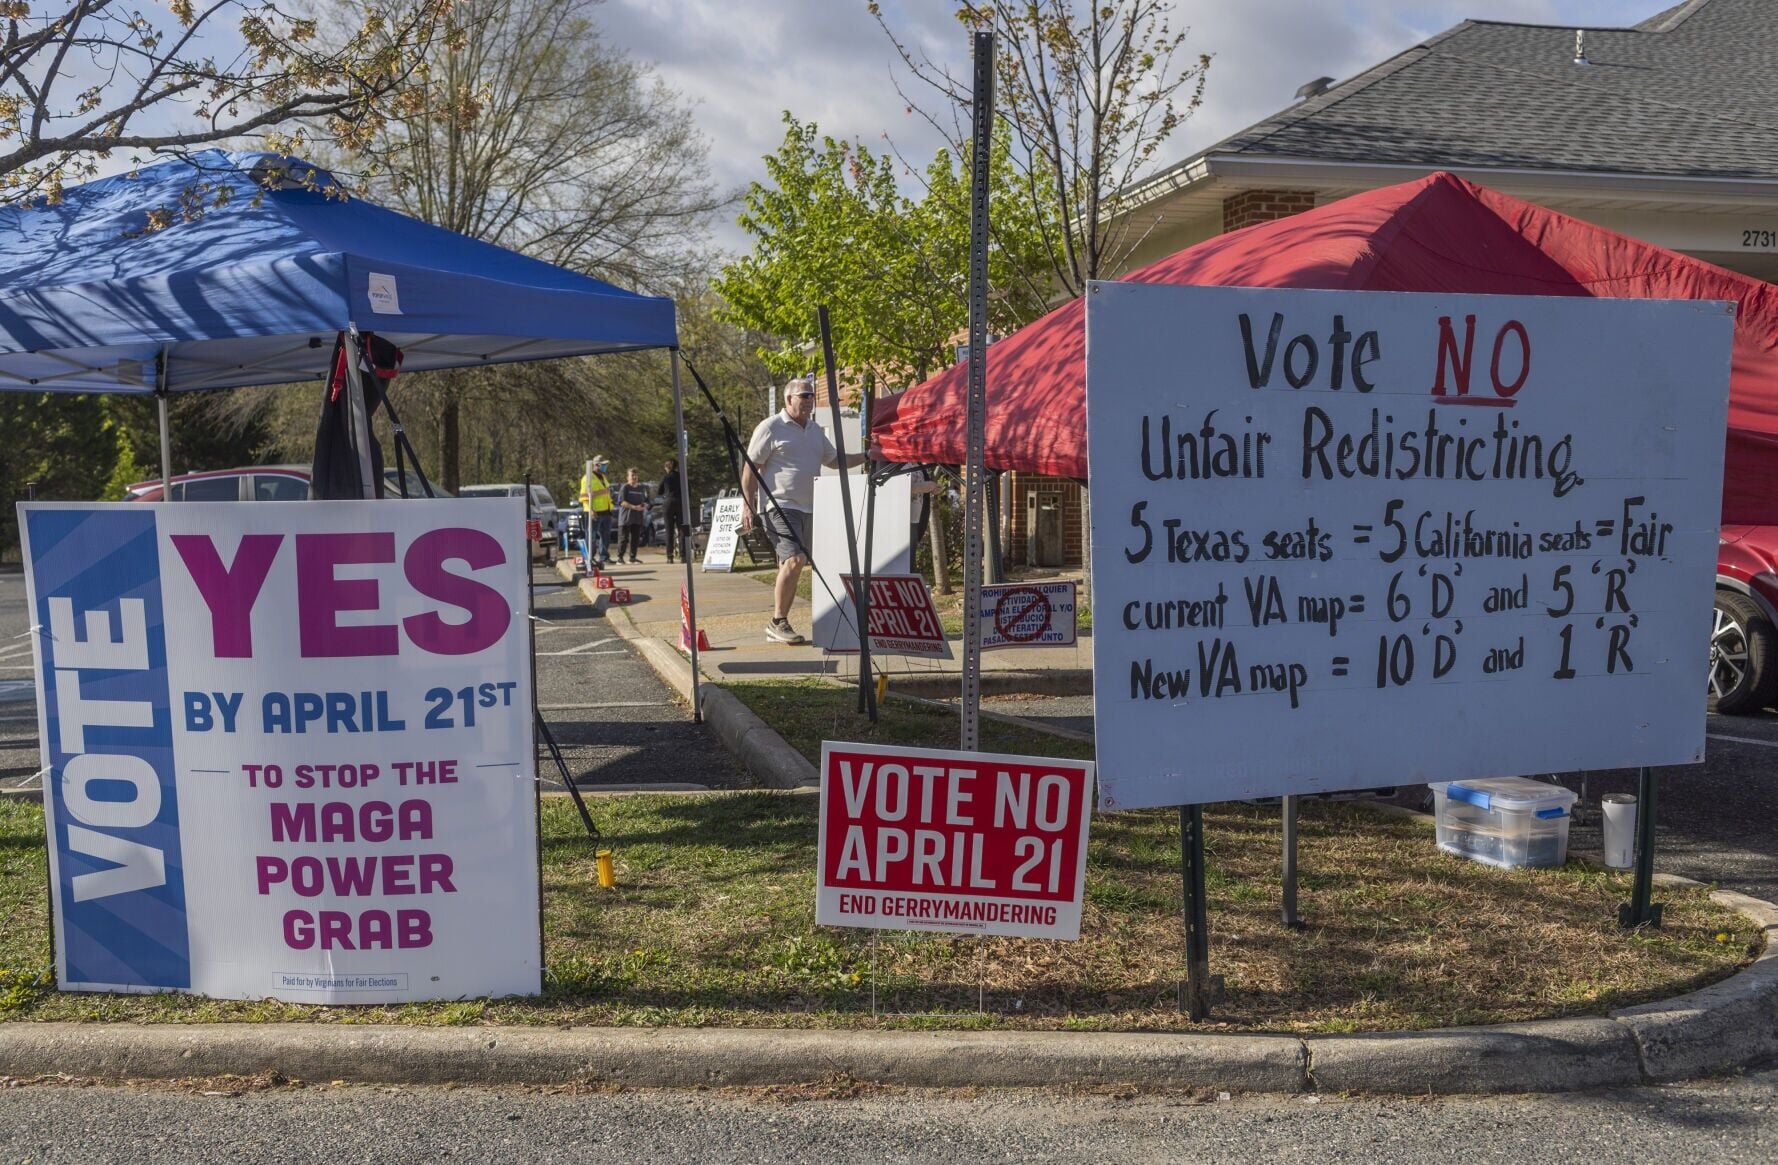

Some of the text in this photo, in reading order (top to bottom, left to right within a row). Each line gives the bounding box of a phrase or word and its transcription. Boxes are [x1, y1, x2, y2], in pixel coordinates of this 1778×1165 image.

[1742, 230, 1777, 247] 2731
[1238, 312, 1531, 398] Vote NO
[1141, 409, 1271, 480] Unfair
[715, 514, 740, 523] VOTING
[719, 524, 733, 532] SITE
[720, 504, 739, 513] EARLY
[1124, 500, 1153, 564] 5
[1163, 517, 1249, 564] Texas
[1262, 516, 1333, 563] seats
[1414, 509, 1533, 561] California
[169, 527, 513, 659] YES
[894, 581, 926, 608] NO
[981, 588, 1020, 598] ROHIBIDA
[1059, 604, 1073, 613] Y/O
[1122, 581, 1228, 631] current
[1244, 575, 1288, 628] VA
[1386, 570, 1411, 623] 6
[1482, 573, 1528, 612] and
[1546, 565, 1575, 619] 5
[873, 639, 887, 649] END
[914, 609, 938, 637] 21
[1130, 658, 1191, 701] New
[1198, 638, 1242, 697] VA
[1249, 657, 1308, 709] map
[1377, 634, 1415, 689] 10
[1481, 637, 1524, 675] and
[1553, 625, 1576, 680] 1
[183, 691, 244, 733] BY
[262, 691, 405, 734] APRIL
[48, 596, 167, 903] VOTE
[241, 760, 459, 789] TO STOP THE
[839, 760, 1071, 832] VOTE NO
[269, 799, 434, 843] MAGA
[256, 853, 458, 897] POWER
[835, 825, 1063, 893] APRIL 21
[282, 909, 434, 951] GRAB
[839, 894, 875, 915] END
[882, 896, 1057, 926] GERRYMANDERING
[282, 976, 296, 986] Paid
[296, 976, 305, 986] for
[306, 977, 314, 988] by
[345, 977, 354, 987] for
[355, 977, 367, 987] Fair
[368, 977, 398, 987] Elections
